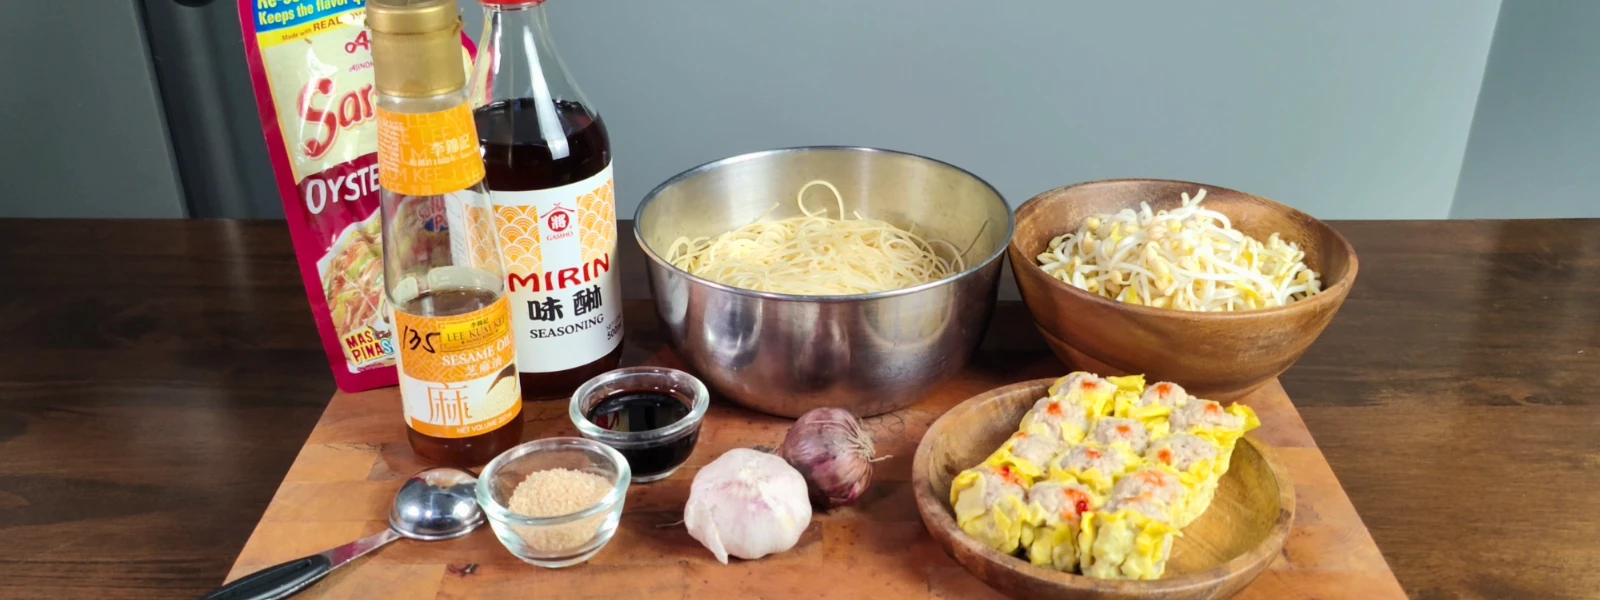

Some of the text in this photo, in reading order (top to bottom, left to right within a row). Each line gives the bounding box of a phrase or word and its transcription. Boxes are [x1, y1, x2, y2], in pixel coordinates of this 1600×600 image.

[258, 10, 295, 25] Keeps
[297, 3, 314, 17] the
[282, 16, 343, 41] Made with REAL
[546, 231, 573, 241] GASSHO
[508, 253, 609, 293] MIRIN
[446, 331, 465, 342] LEE
[469, 326, 492, 338] KUM
[530, 313, 604, 339] SEASONING
[346, 330, 374, 350] MAS
[403, 325, 441, 354] 135
[442, 344, 495, 366] SESAME
[497, 335, 511, 353] OIL
[472, 418, 498, 432] VOLUME
